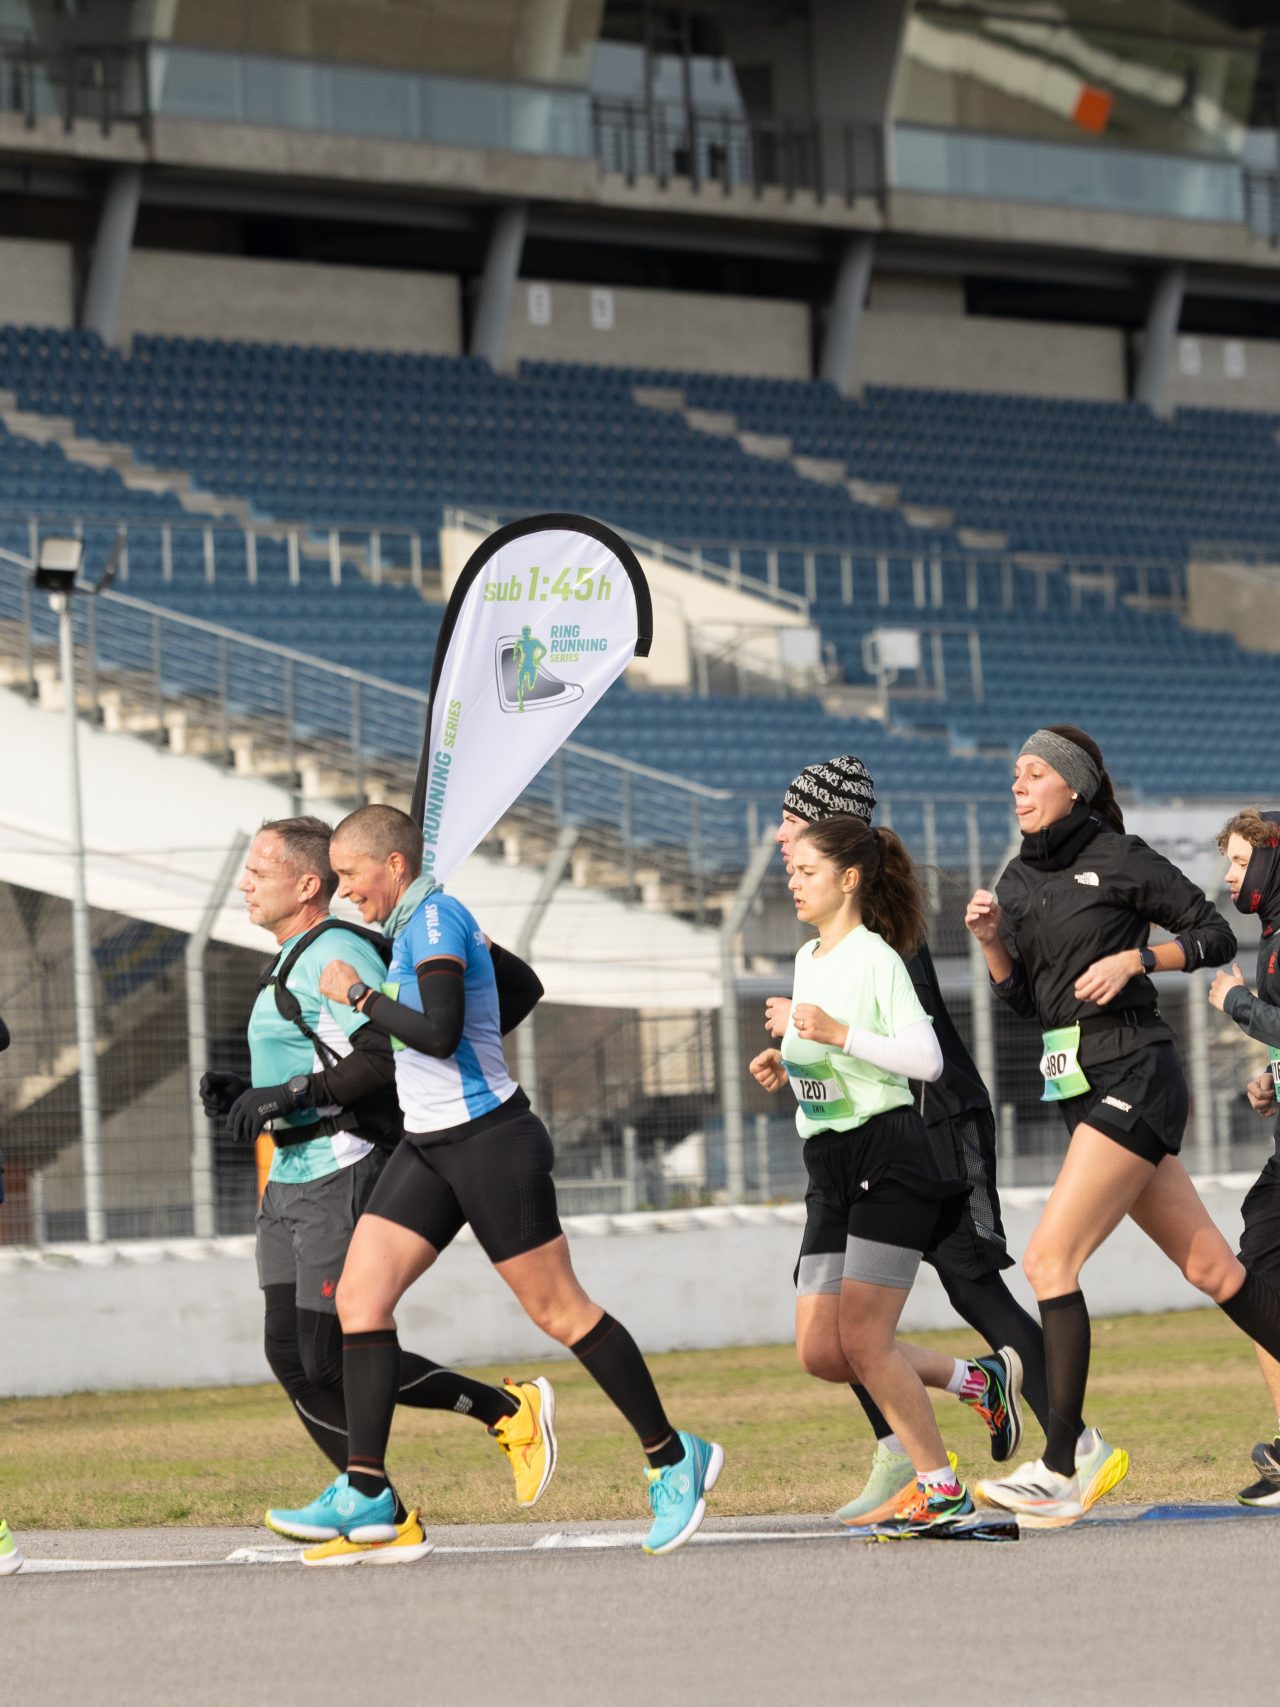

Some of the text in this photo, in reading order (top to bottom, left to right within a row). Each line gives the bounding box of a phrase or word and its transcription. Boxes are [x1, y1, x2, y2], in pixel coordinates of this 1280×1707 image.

[484, 567, 612, 602] sub 1:45 h
[551, 625, 580, 638] RING
[551, 638, 608, 653] RUNNING
[550, 653, 579, 663] SERIES
[424, 751, 452, 845] RUNNING
[443, 699, 461, 748] SERIES
[799, 1079, 826, 1100] 1207
